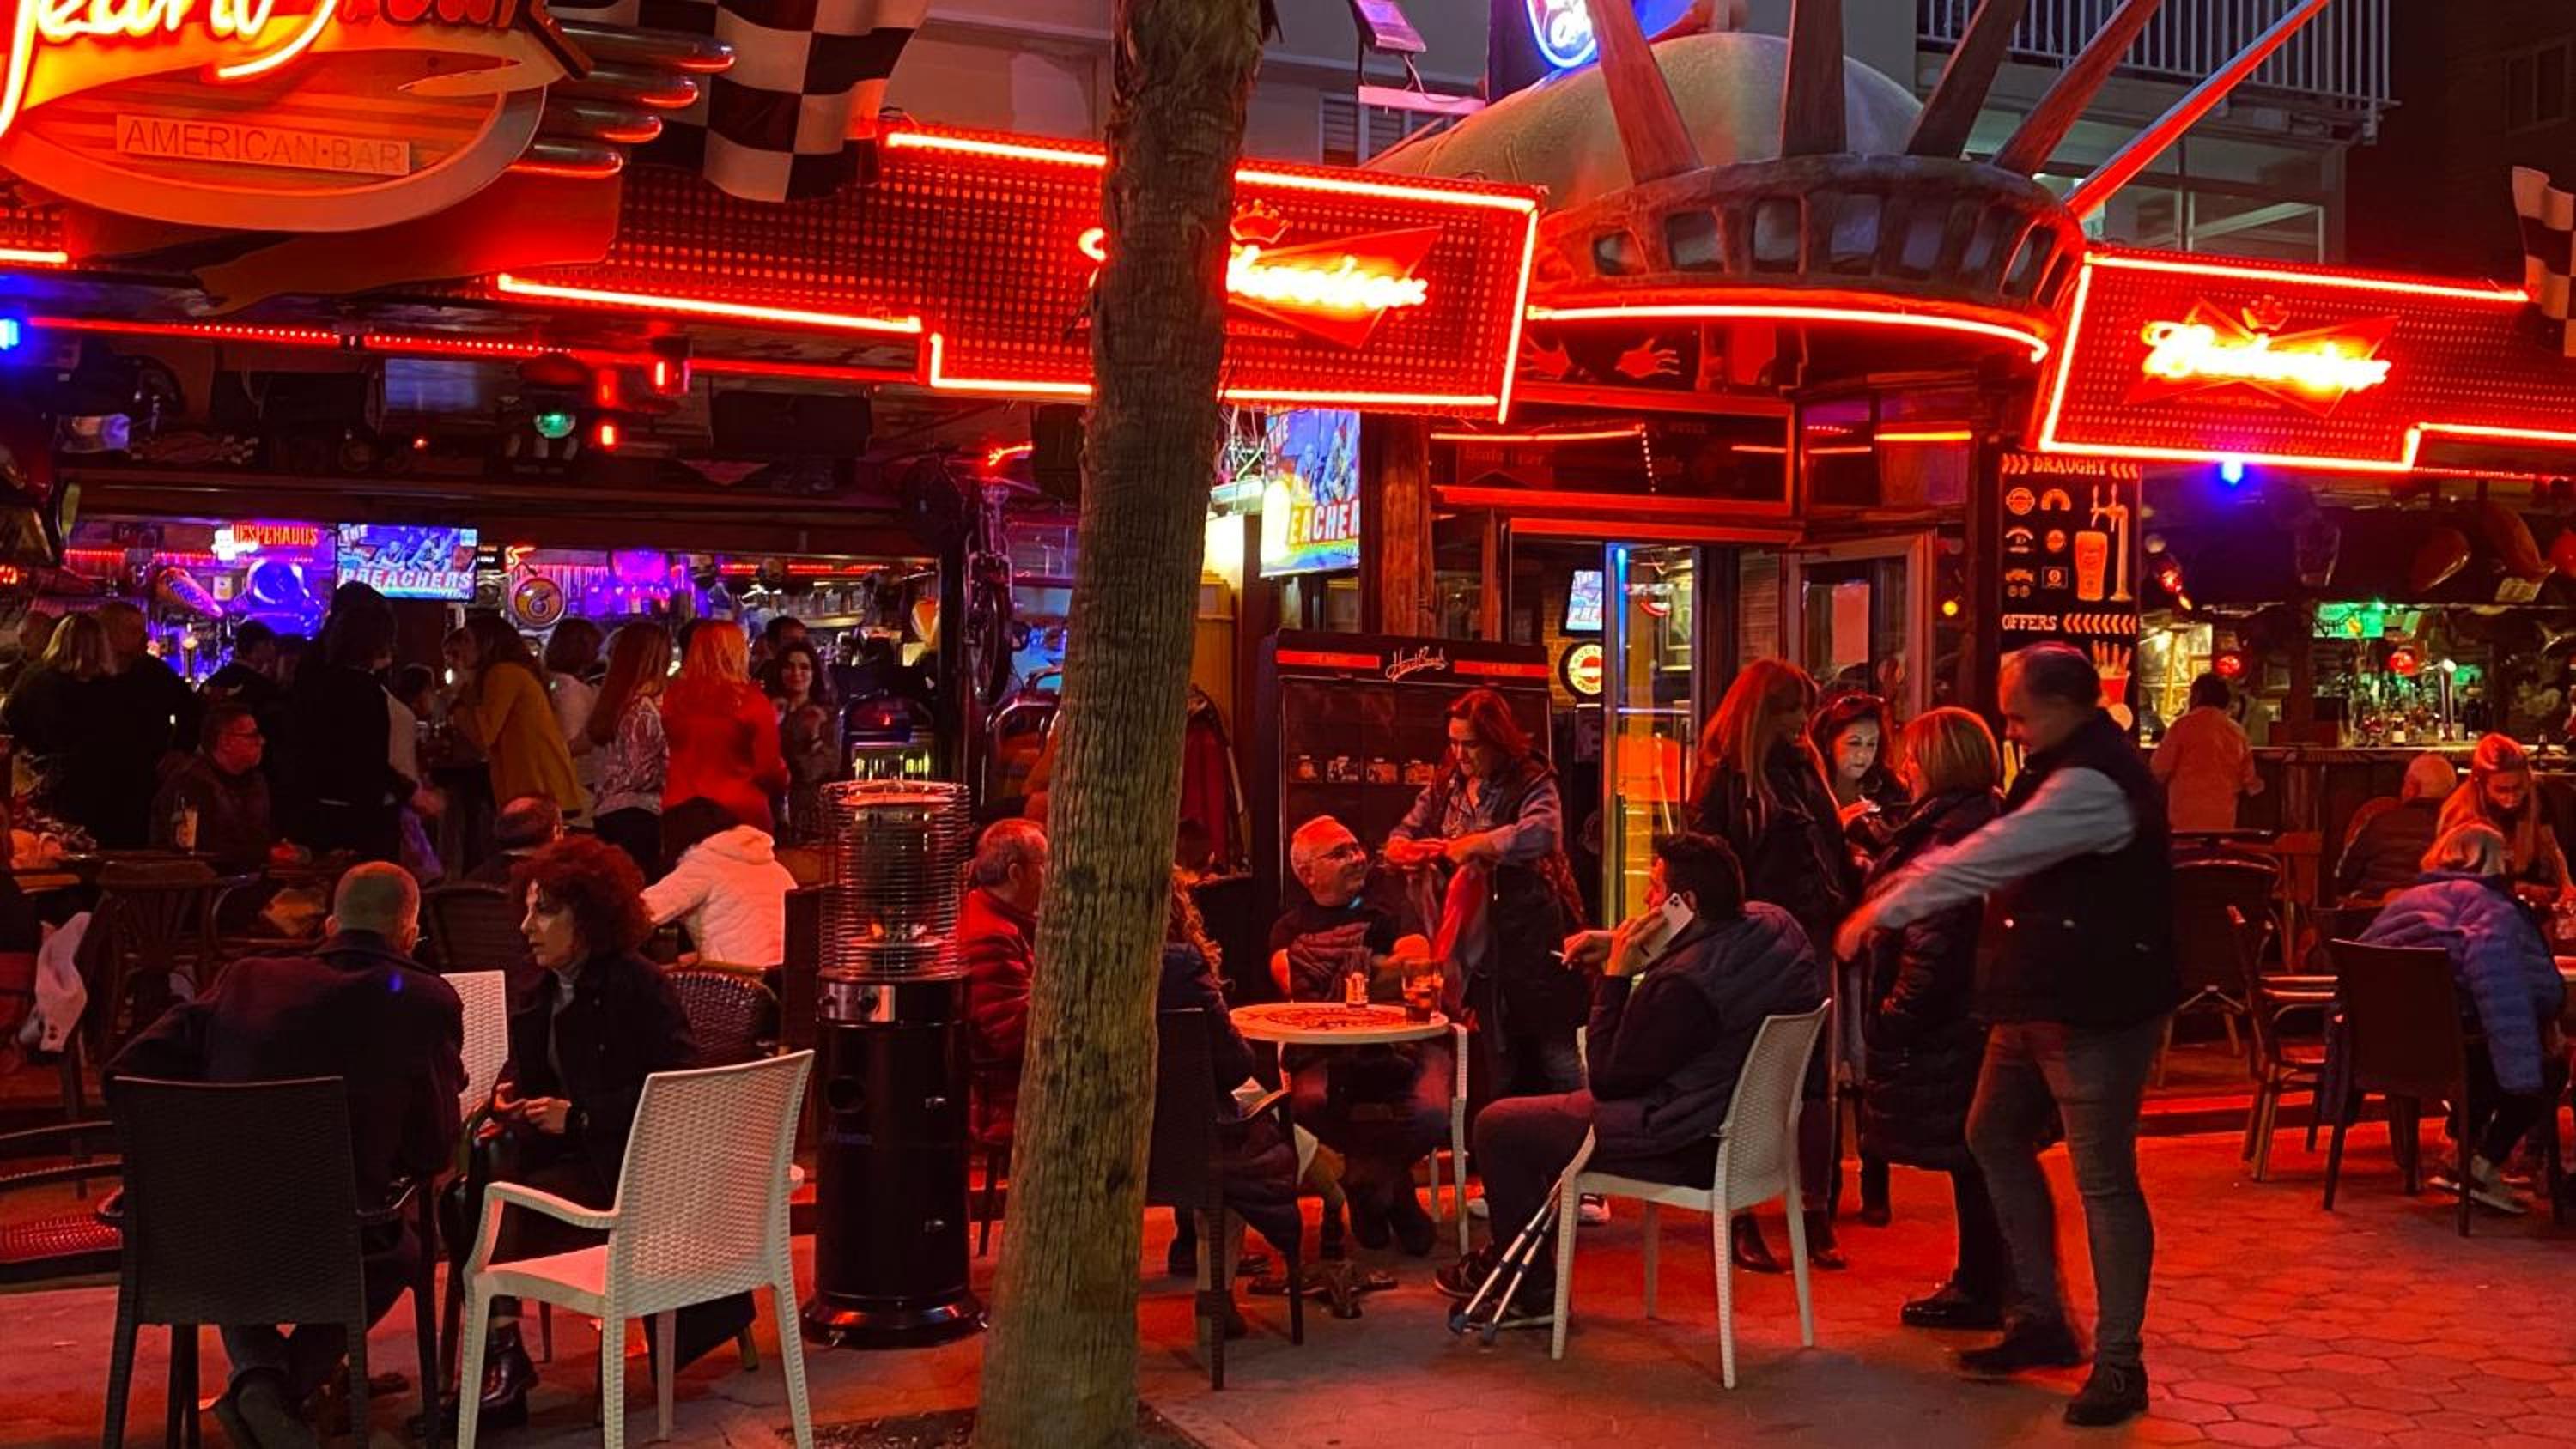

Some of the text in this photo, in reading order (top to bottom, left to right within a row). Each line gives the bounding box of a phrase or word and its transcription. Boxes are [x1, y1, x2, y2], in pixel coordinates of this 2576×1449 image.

[124, 118, 402, 173] AMERICAN BAR
[2032, 455, 2106, 475] DRAUGHT
[2002, 614, 2058, 631] OFFERS
